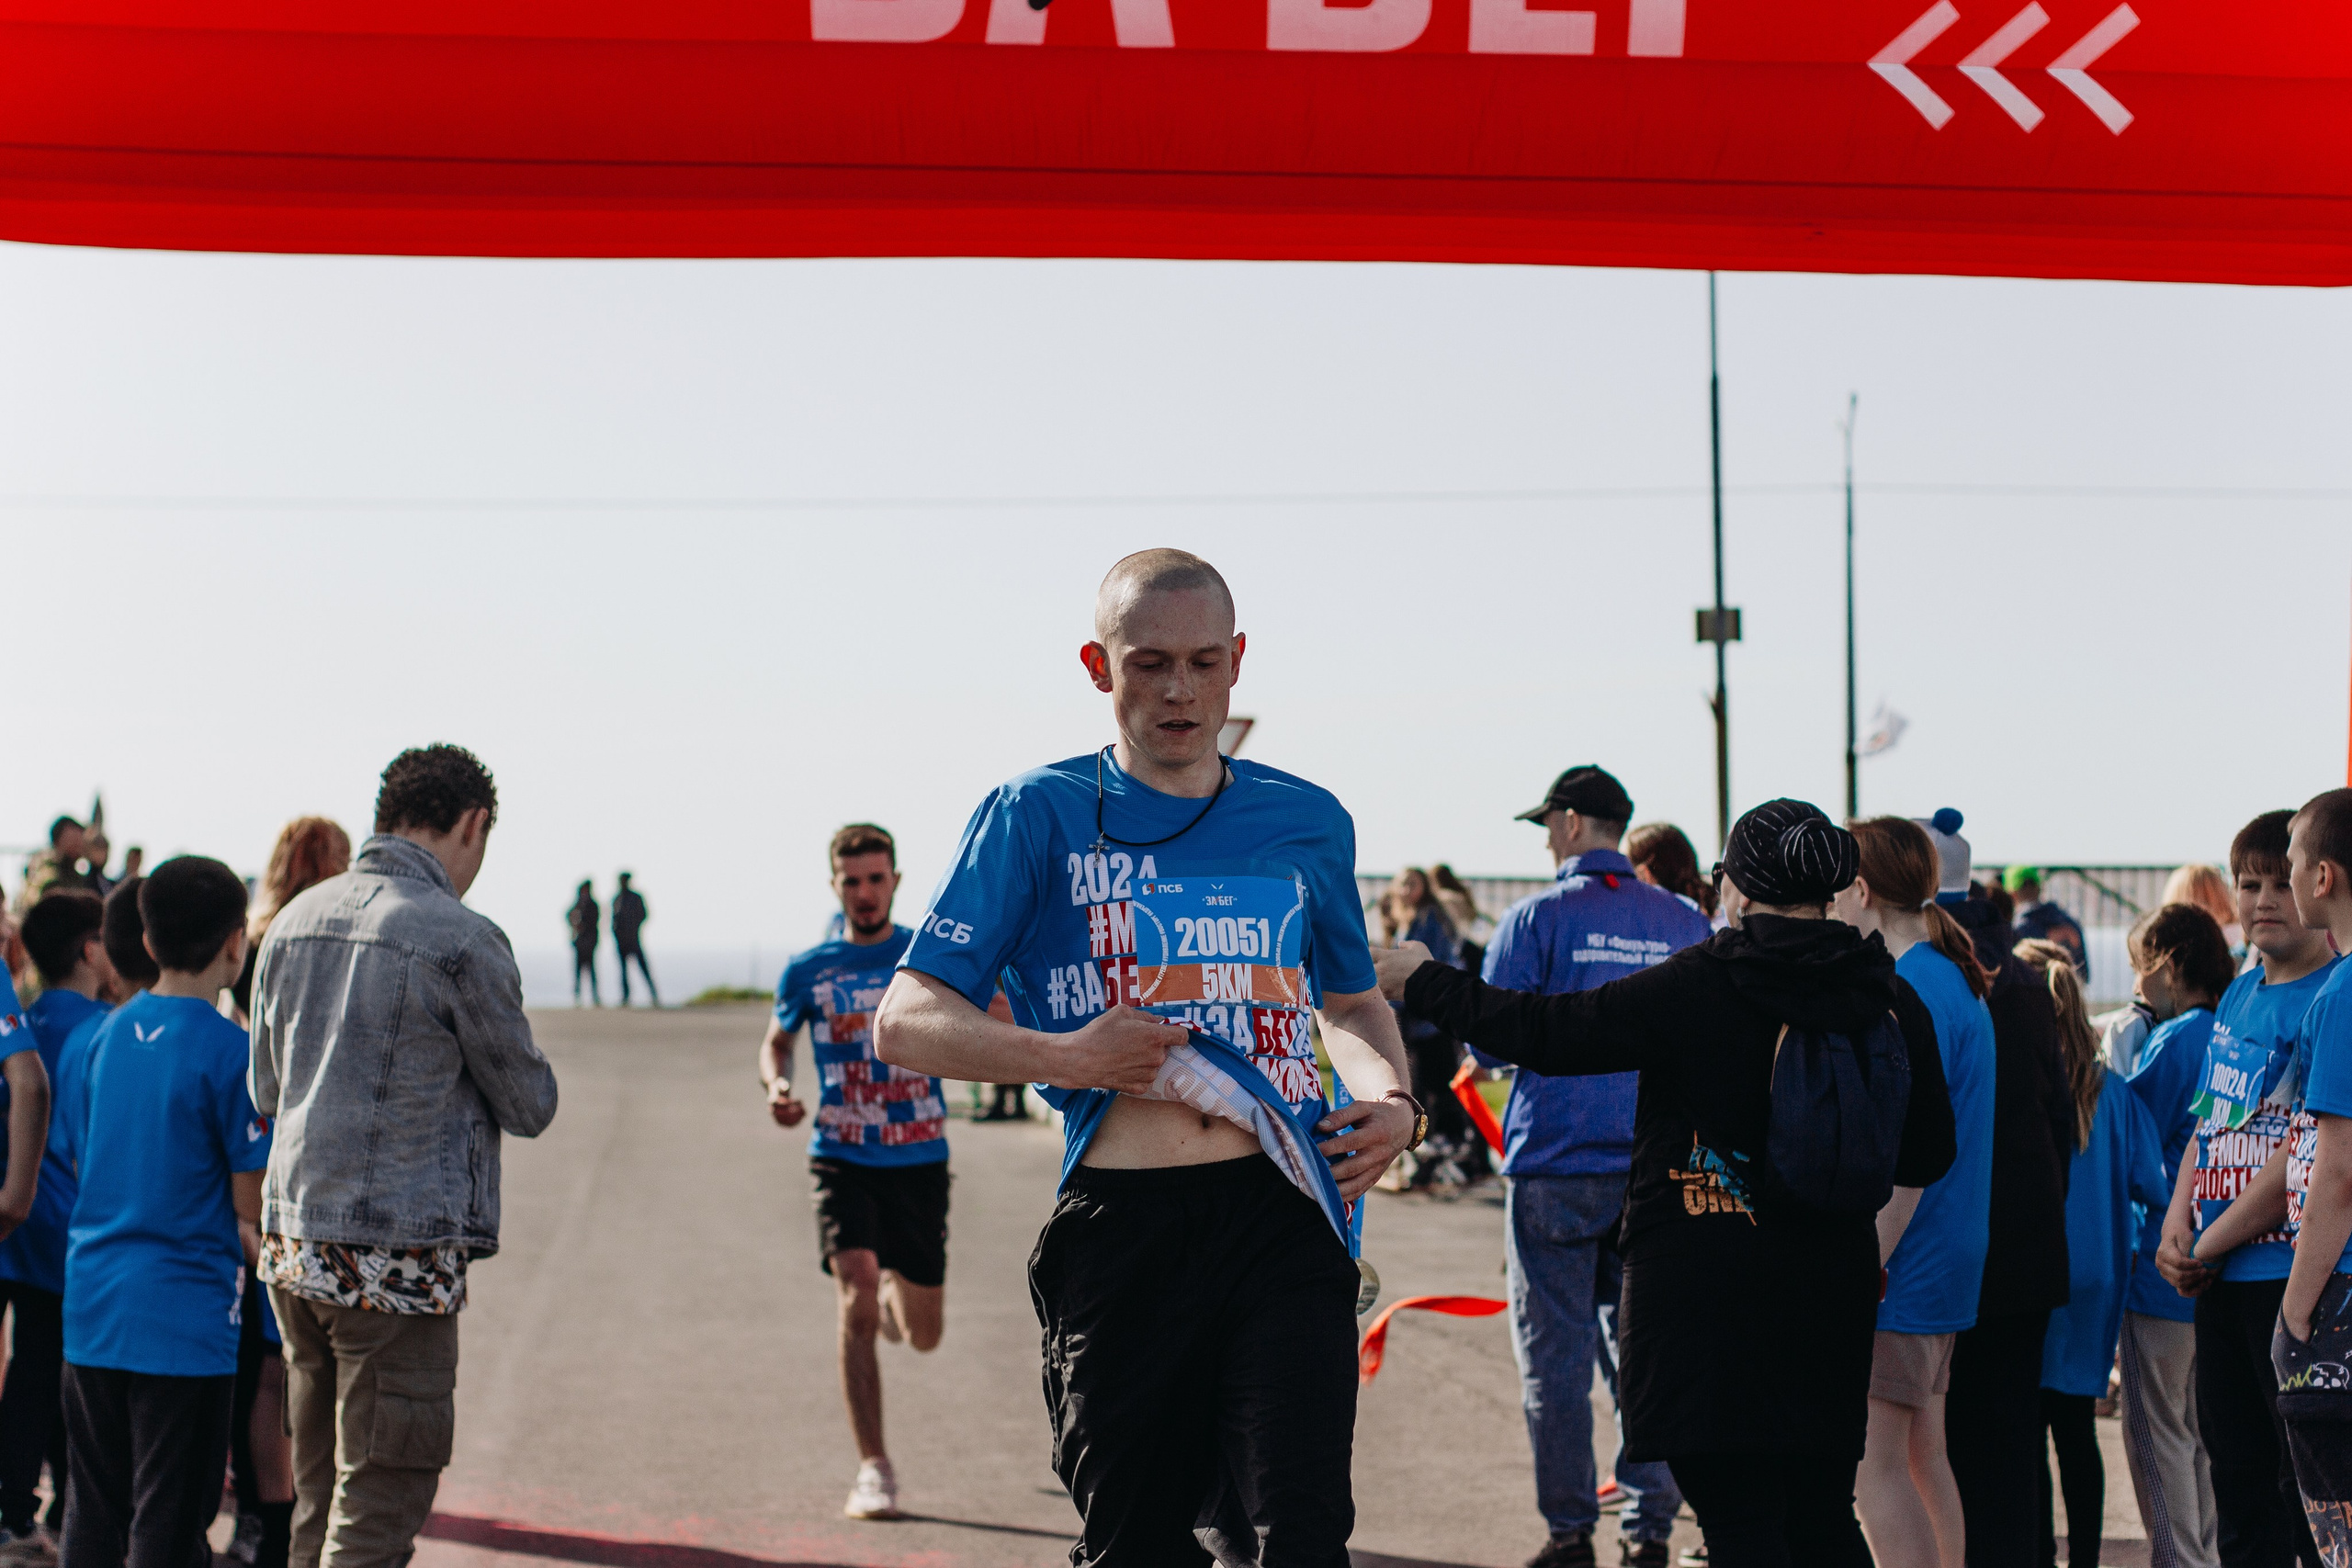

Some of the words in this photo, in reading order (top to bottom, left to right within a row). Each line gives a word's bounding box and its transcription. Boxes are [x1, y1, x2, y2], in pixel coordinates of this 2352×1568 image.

[1159, 884, 1183, 894] ПСБ
[1174, 917, 1270, 958] 20051
[2211, 1062, 2248, 1100] 10024
